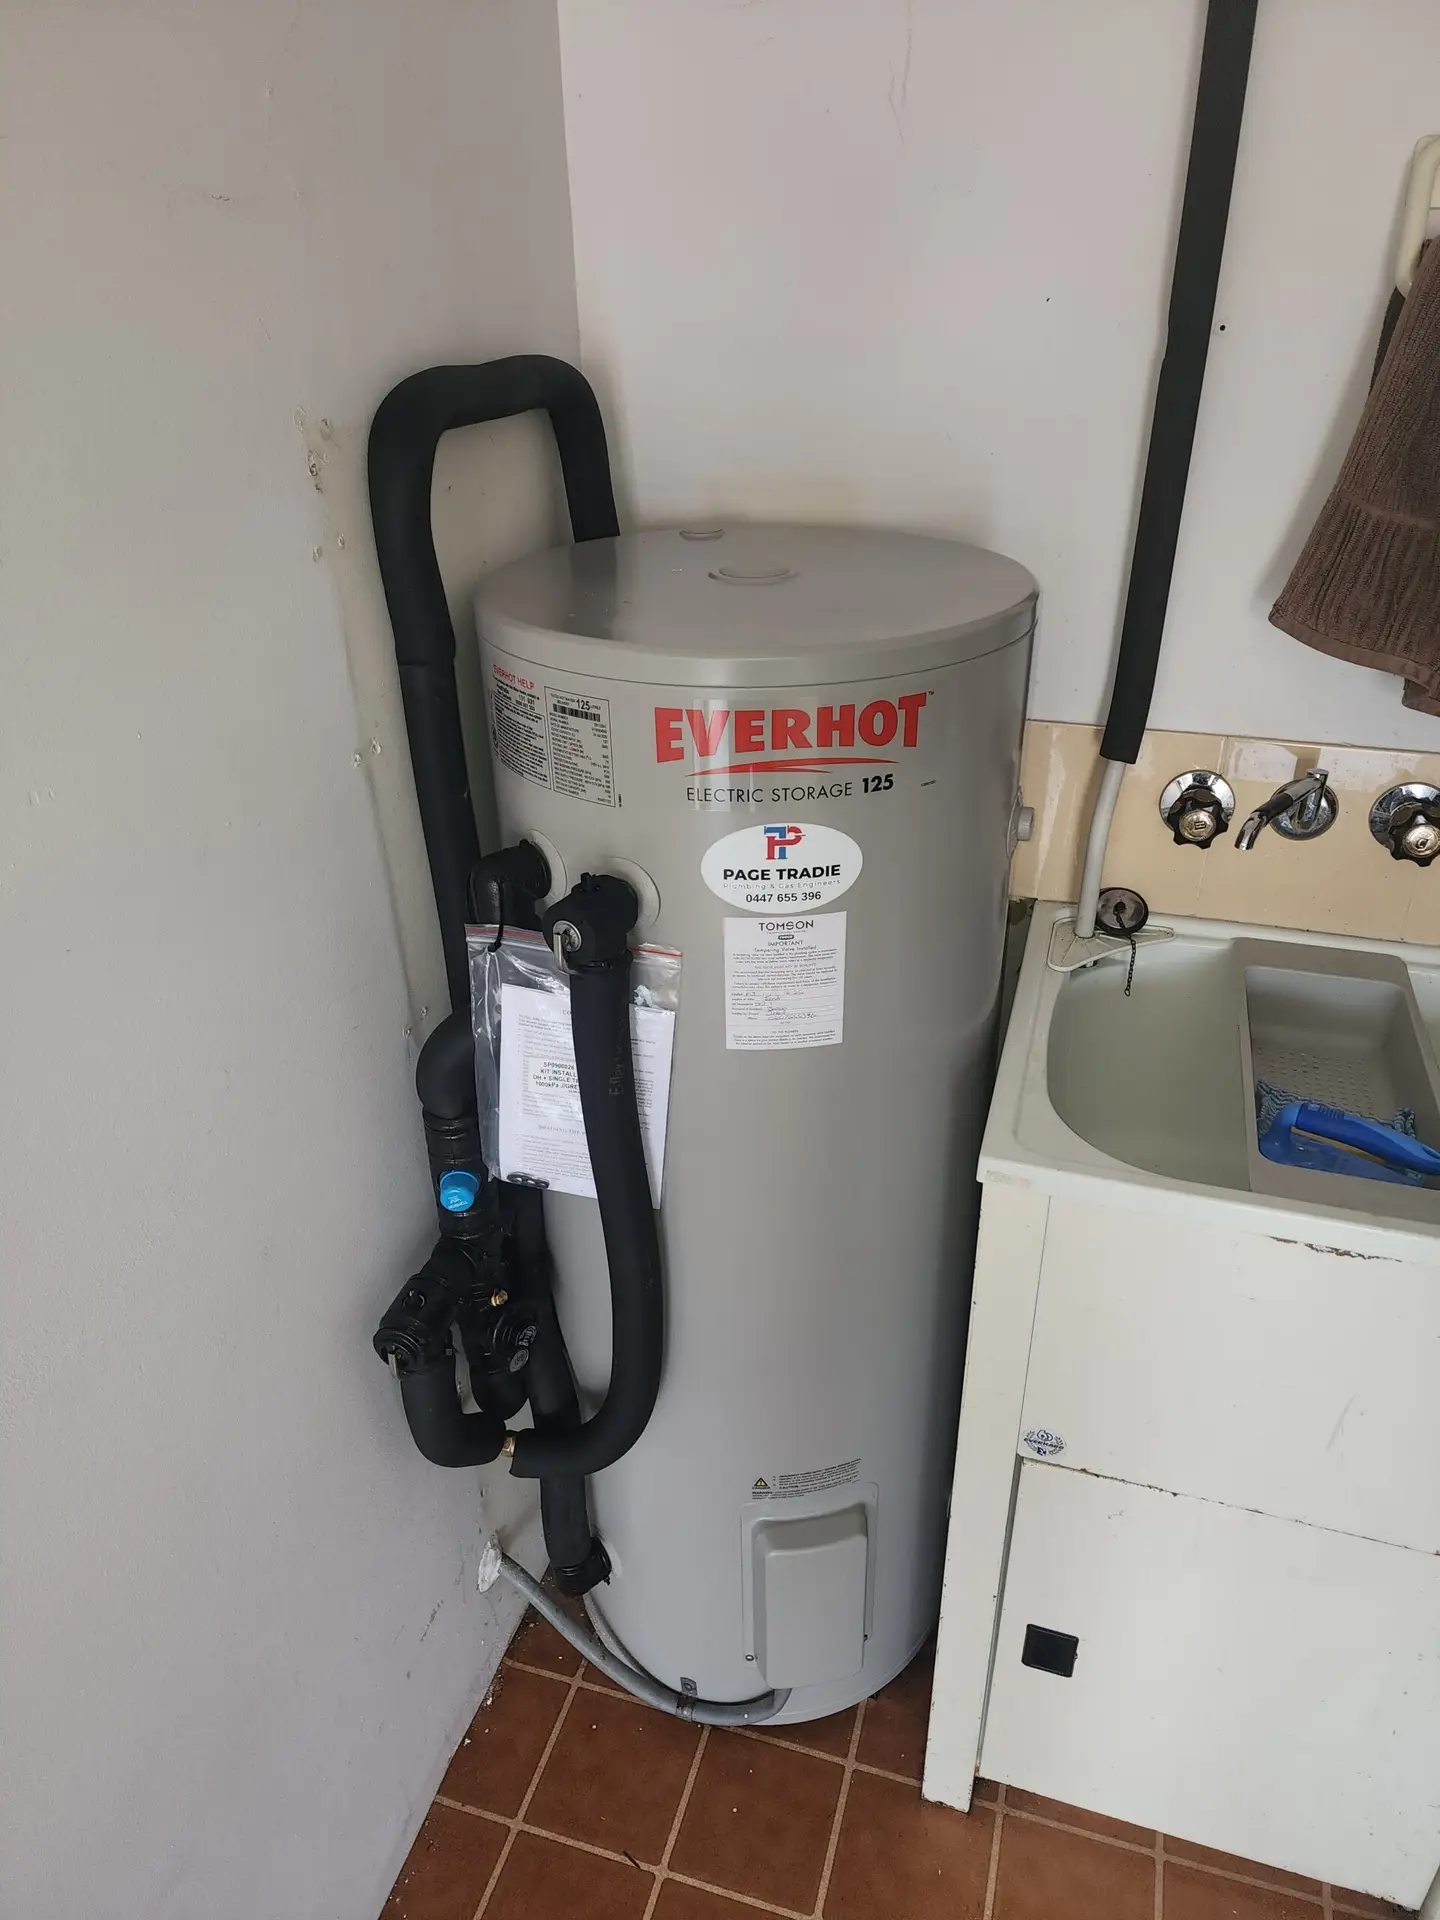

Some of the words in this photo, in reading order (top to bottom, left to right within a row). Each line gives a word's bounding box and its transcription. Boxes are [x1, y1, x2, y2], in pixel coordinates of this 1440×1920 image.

[517, 676, 535, 690] HELP
[576, 698, 591, 711] 125
[654, 692, 927, 763] EVERHOT
[687, 787, 764, 802] ELECTRIC
[771, 782, 853, 802] STORAGE
[862, 774, 894, 794] 125
[723, 869, 771, 881] PAGE
[776, 864, 841, 880] TRADIE
[723, 883, 766, 891] Plumbing
[798, 880, 841, 889] Engineers
[745, 893, 774, 903] 0447
[777, 893, 798, 902] 655
[802, 891, 822, 901] 396
[758, 920, 814, 932] TOMSON
